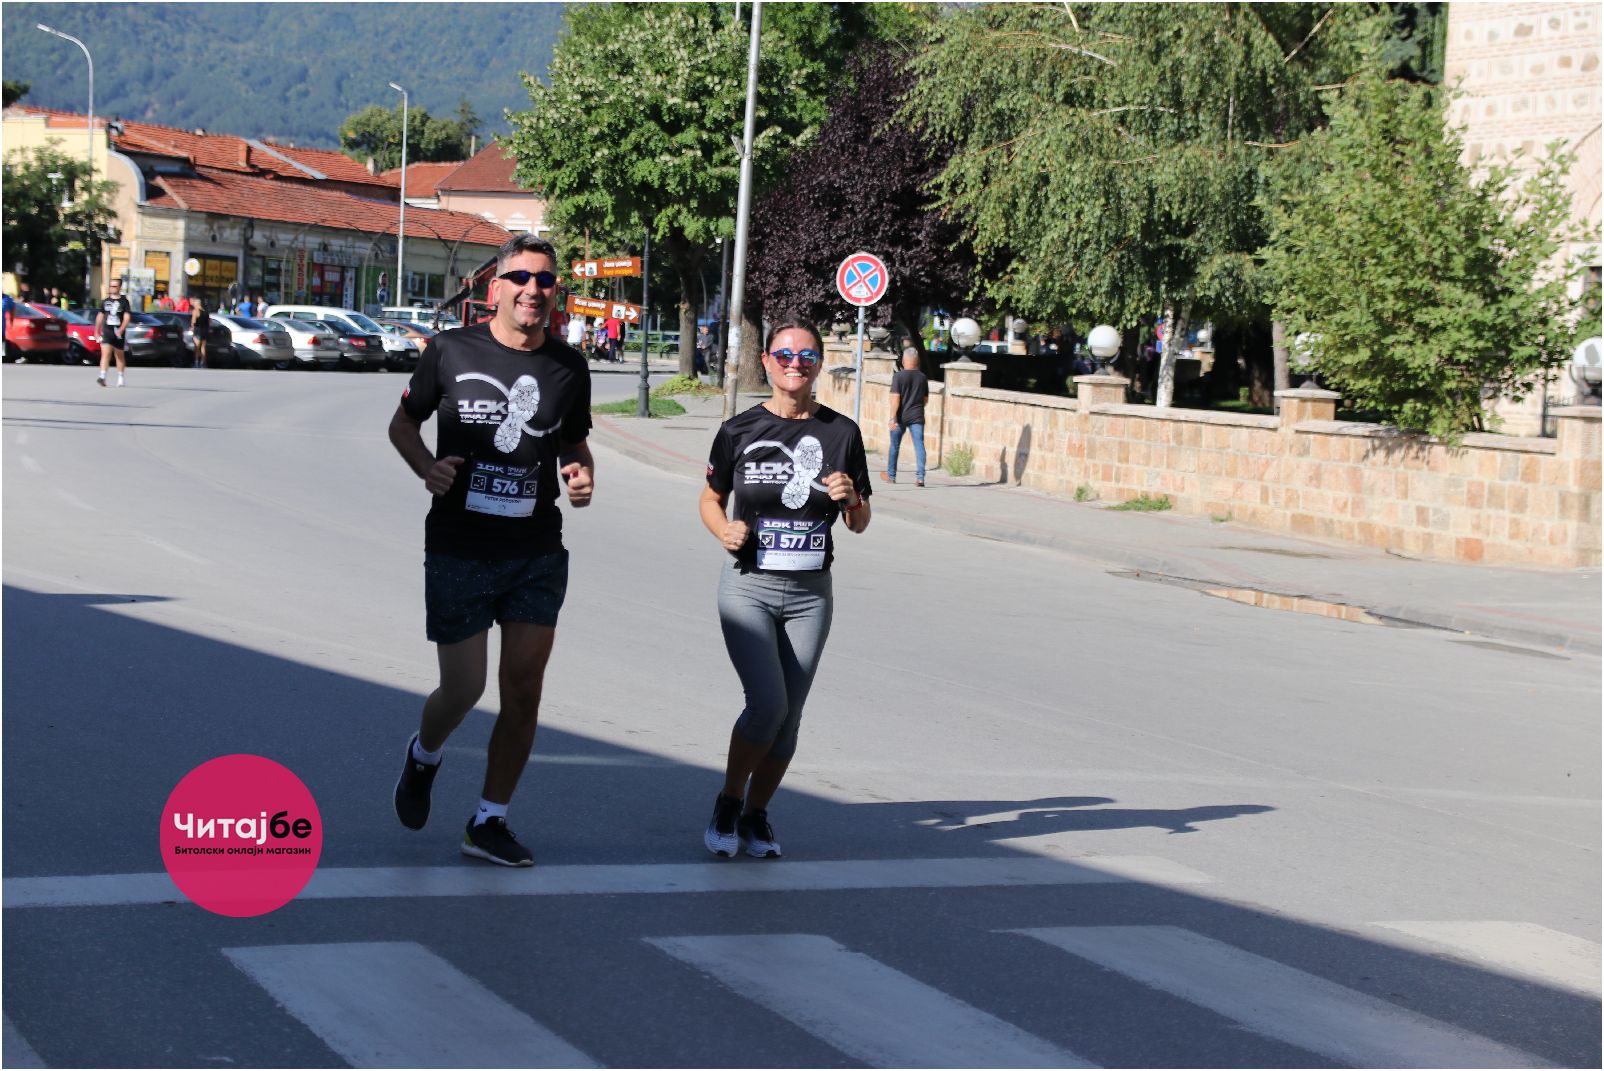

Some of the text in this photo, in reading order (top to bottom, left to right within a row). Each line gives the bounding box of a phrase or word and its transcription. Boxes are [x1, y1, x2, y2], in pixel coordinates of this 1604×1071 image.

[458, 399, 509, 415] 10K
[744, 462, 795, 475] 10K
[492, 478, 519, 495] 576
[763, 520, 791, 529] 10K
[779, 534, 807, 549] 577
